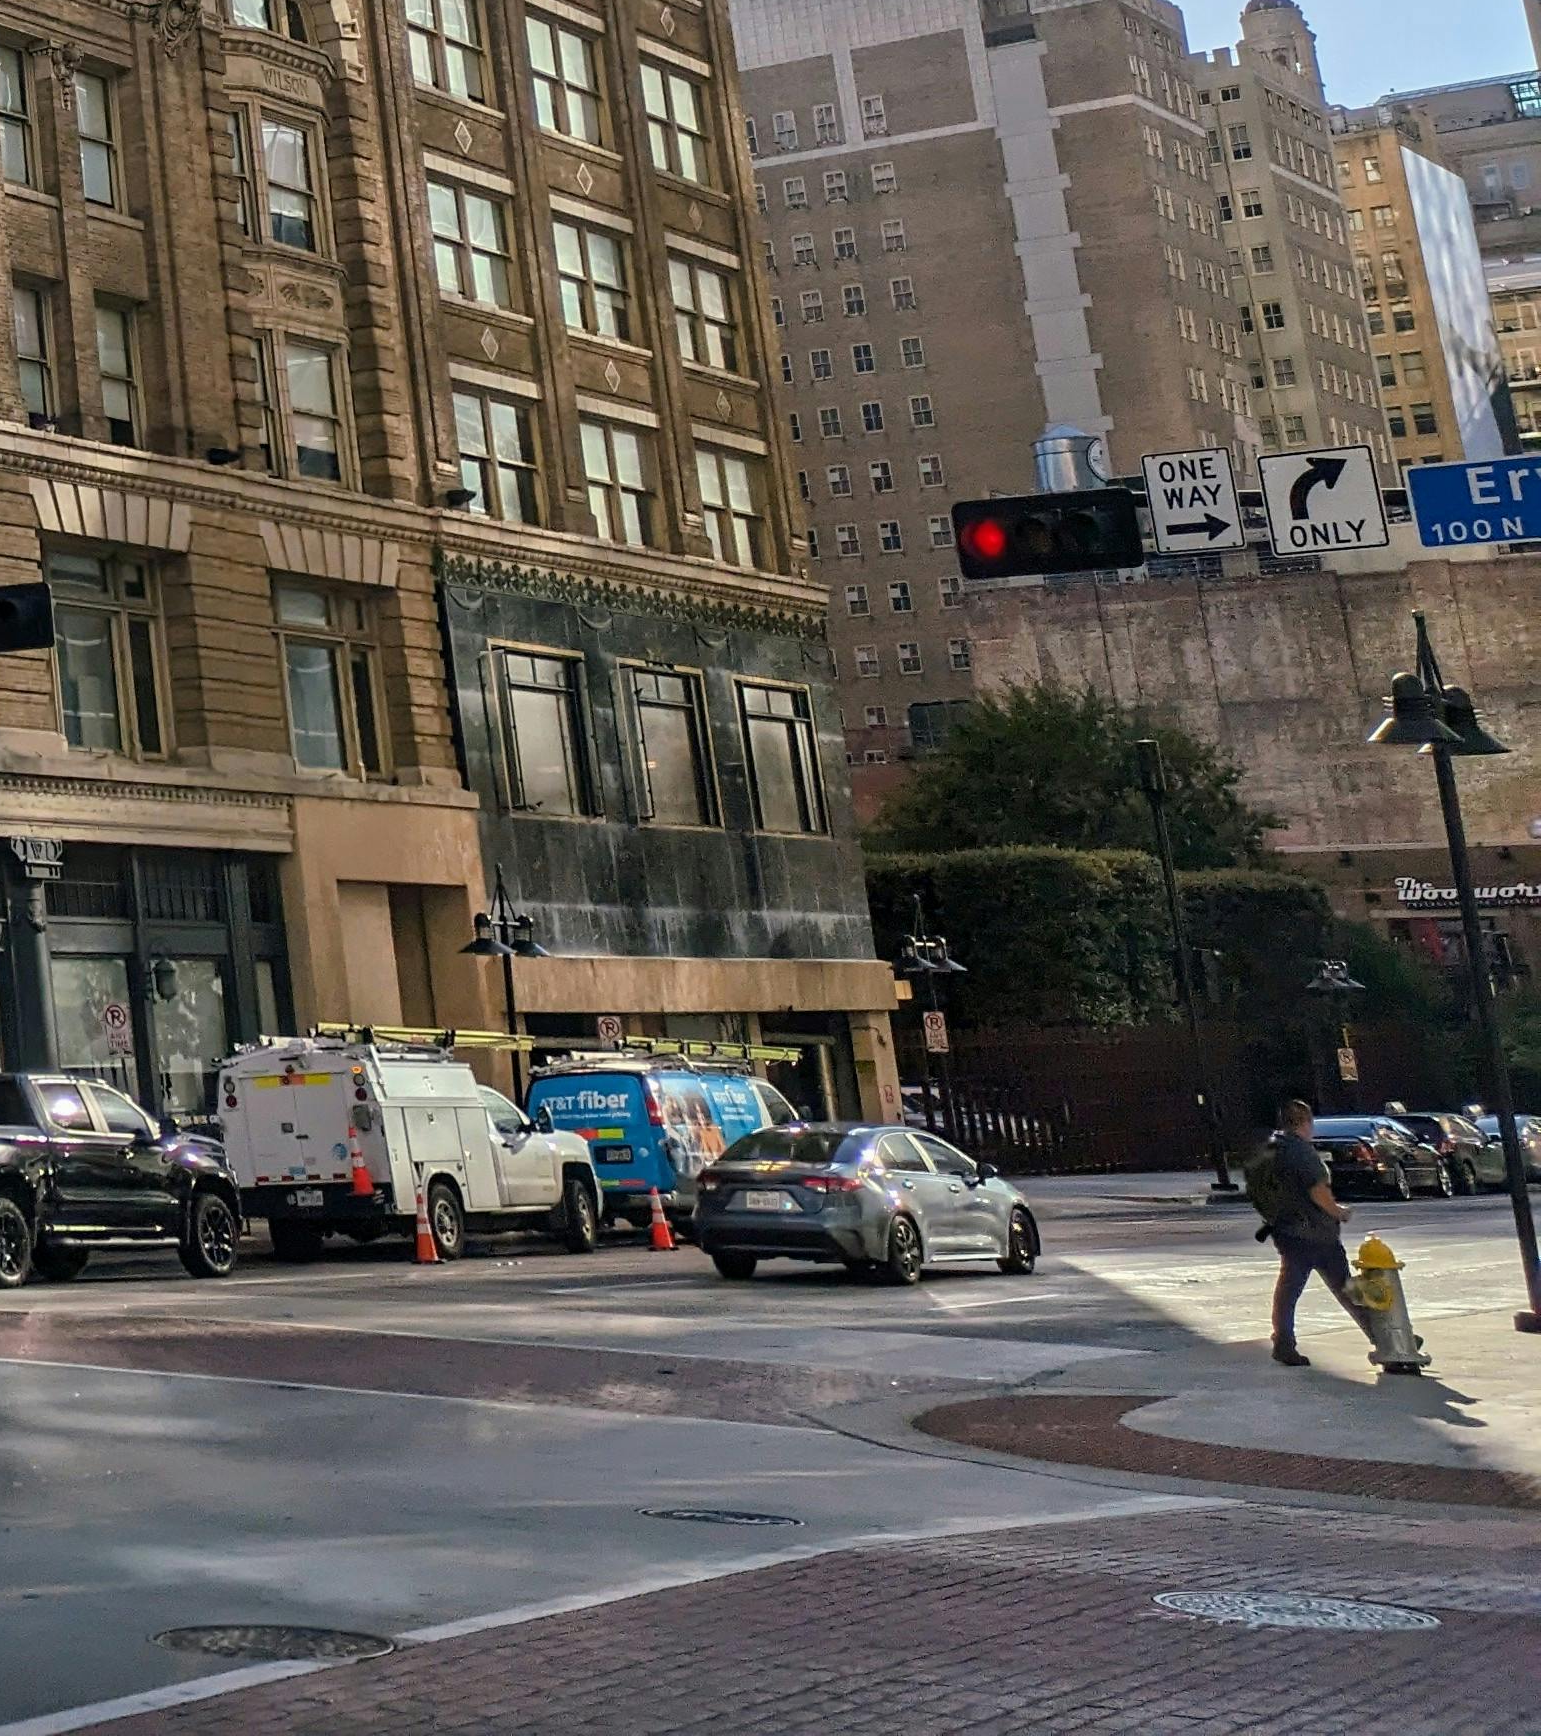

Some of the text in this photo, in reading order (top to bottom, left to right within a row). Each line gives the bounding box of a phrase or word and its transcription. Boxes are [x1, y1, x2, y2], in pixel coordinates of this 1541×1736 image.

[1159, 457, 1217, 483] ONE
[1163, 484, 1221, 510] WAY
[1290, 519, 1366, 548] ONLY
[1431, 516, 1524, 543] 100 N
[1395, 877, 1435, 890] The
[540, 1090, 628, 1111] AT&T fiber
